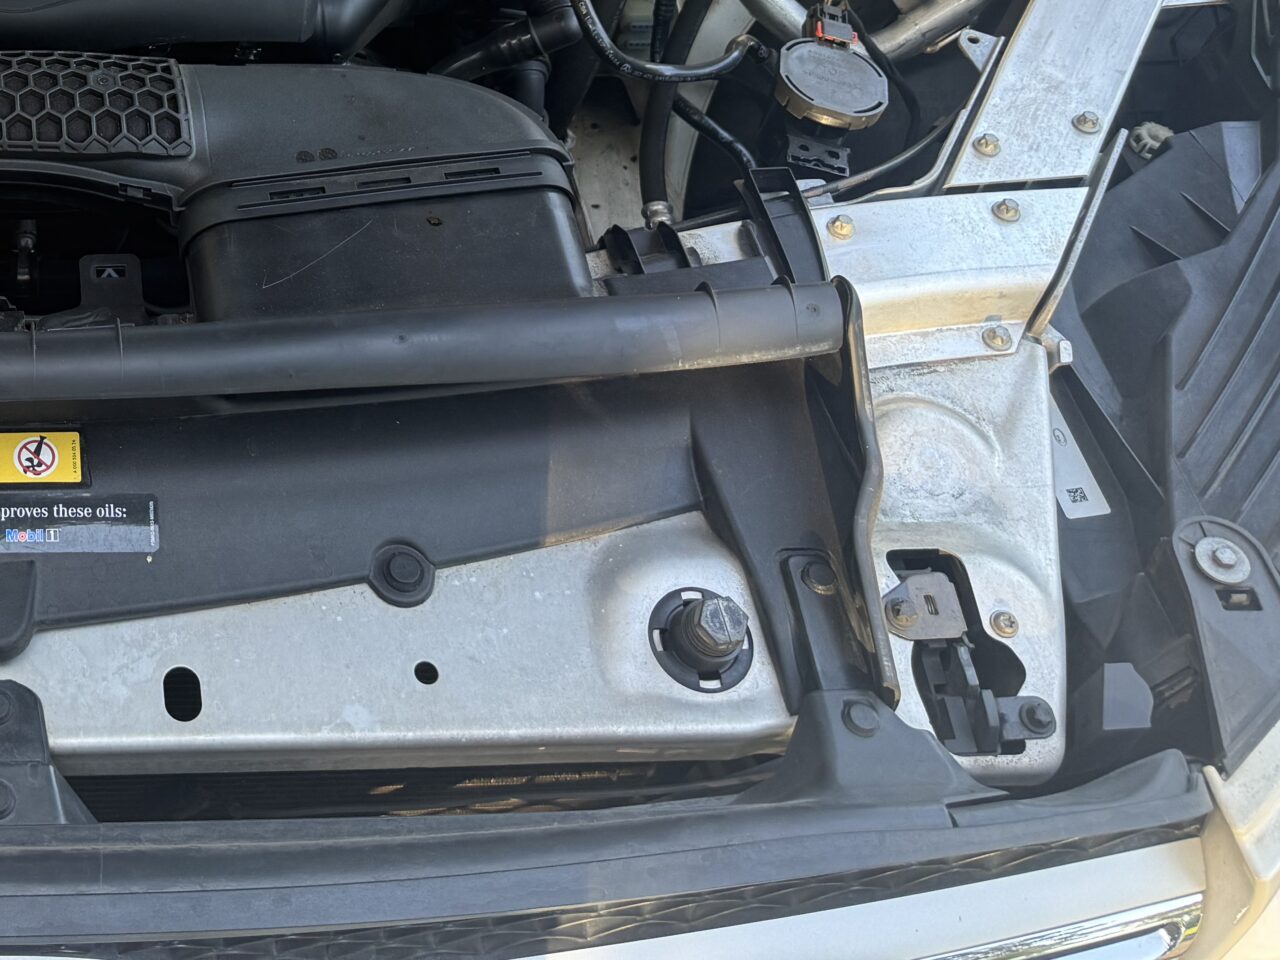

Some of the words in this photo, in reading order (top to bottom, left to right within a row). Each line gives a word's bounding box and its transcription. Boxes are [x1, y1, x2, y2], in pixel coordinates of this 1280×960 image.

[53, 503, 92, 518] these
[96, 503, 127, 518] oils:
[5, 528, 44, 542] Mobil
